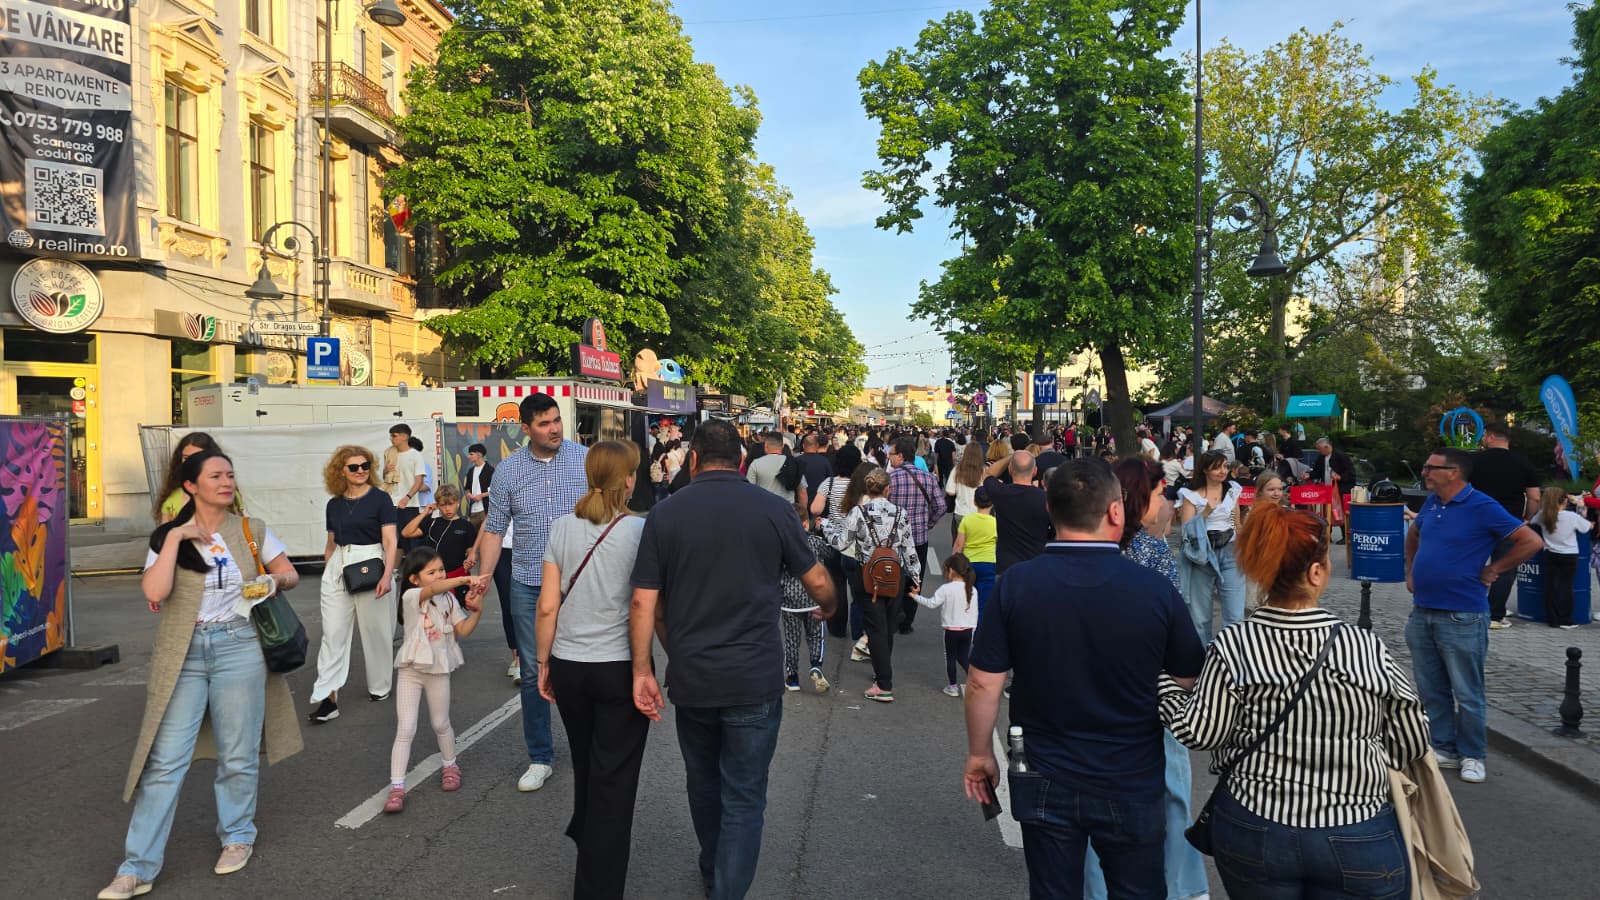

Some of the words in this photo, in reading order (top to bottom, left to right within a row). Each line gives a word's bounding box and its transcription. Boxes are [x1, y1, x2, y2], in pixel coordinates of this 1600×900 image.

[27, 11, 124, 56] VÂNZARE
[14, 64, 119, 95] APARTAMENTE
[25, 82, 102, 107] RENOVATE
[14, 112, 57, 131] 0753
[61, 118, 92, 137] 779
[96, 125, 123, 143] 988
[33, 134, 95, 153] Scanează
[36, 148, 72, 161] codul
[74, 152, 93, 164] QR
[38, 238, 128, 257] realimo.ro
[30, 273, 48, 289] THE
[51, 271, 86, 293] COFFEE
[315, 342, 332, 365] P
[1353, 532, 1389, 545] PERONI
